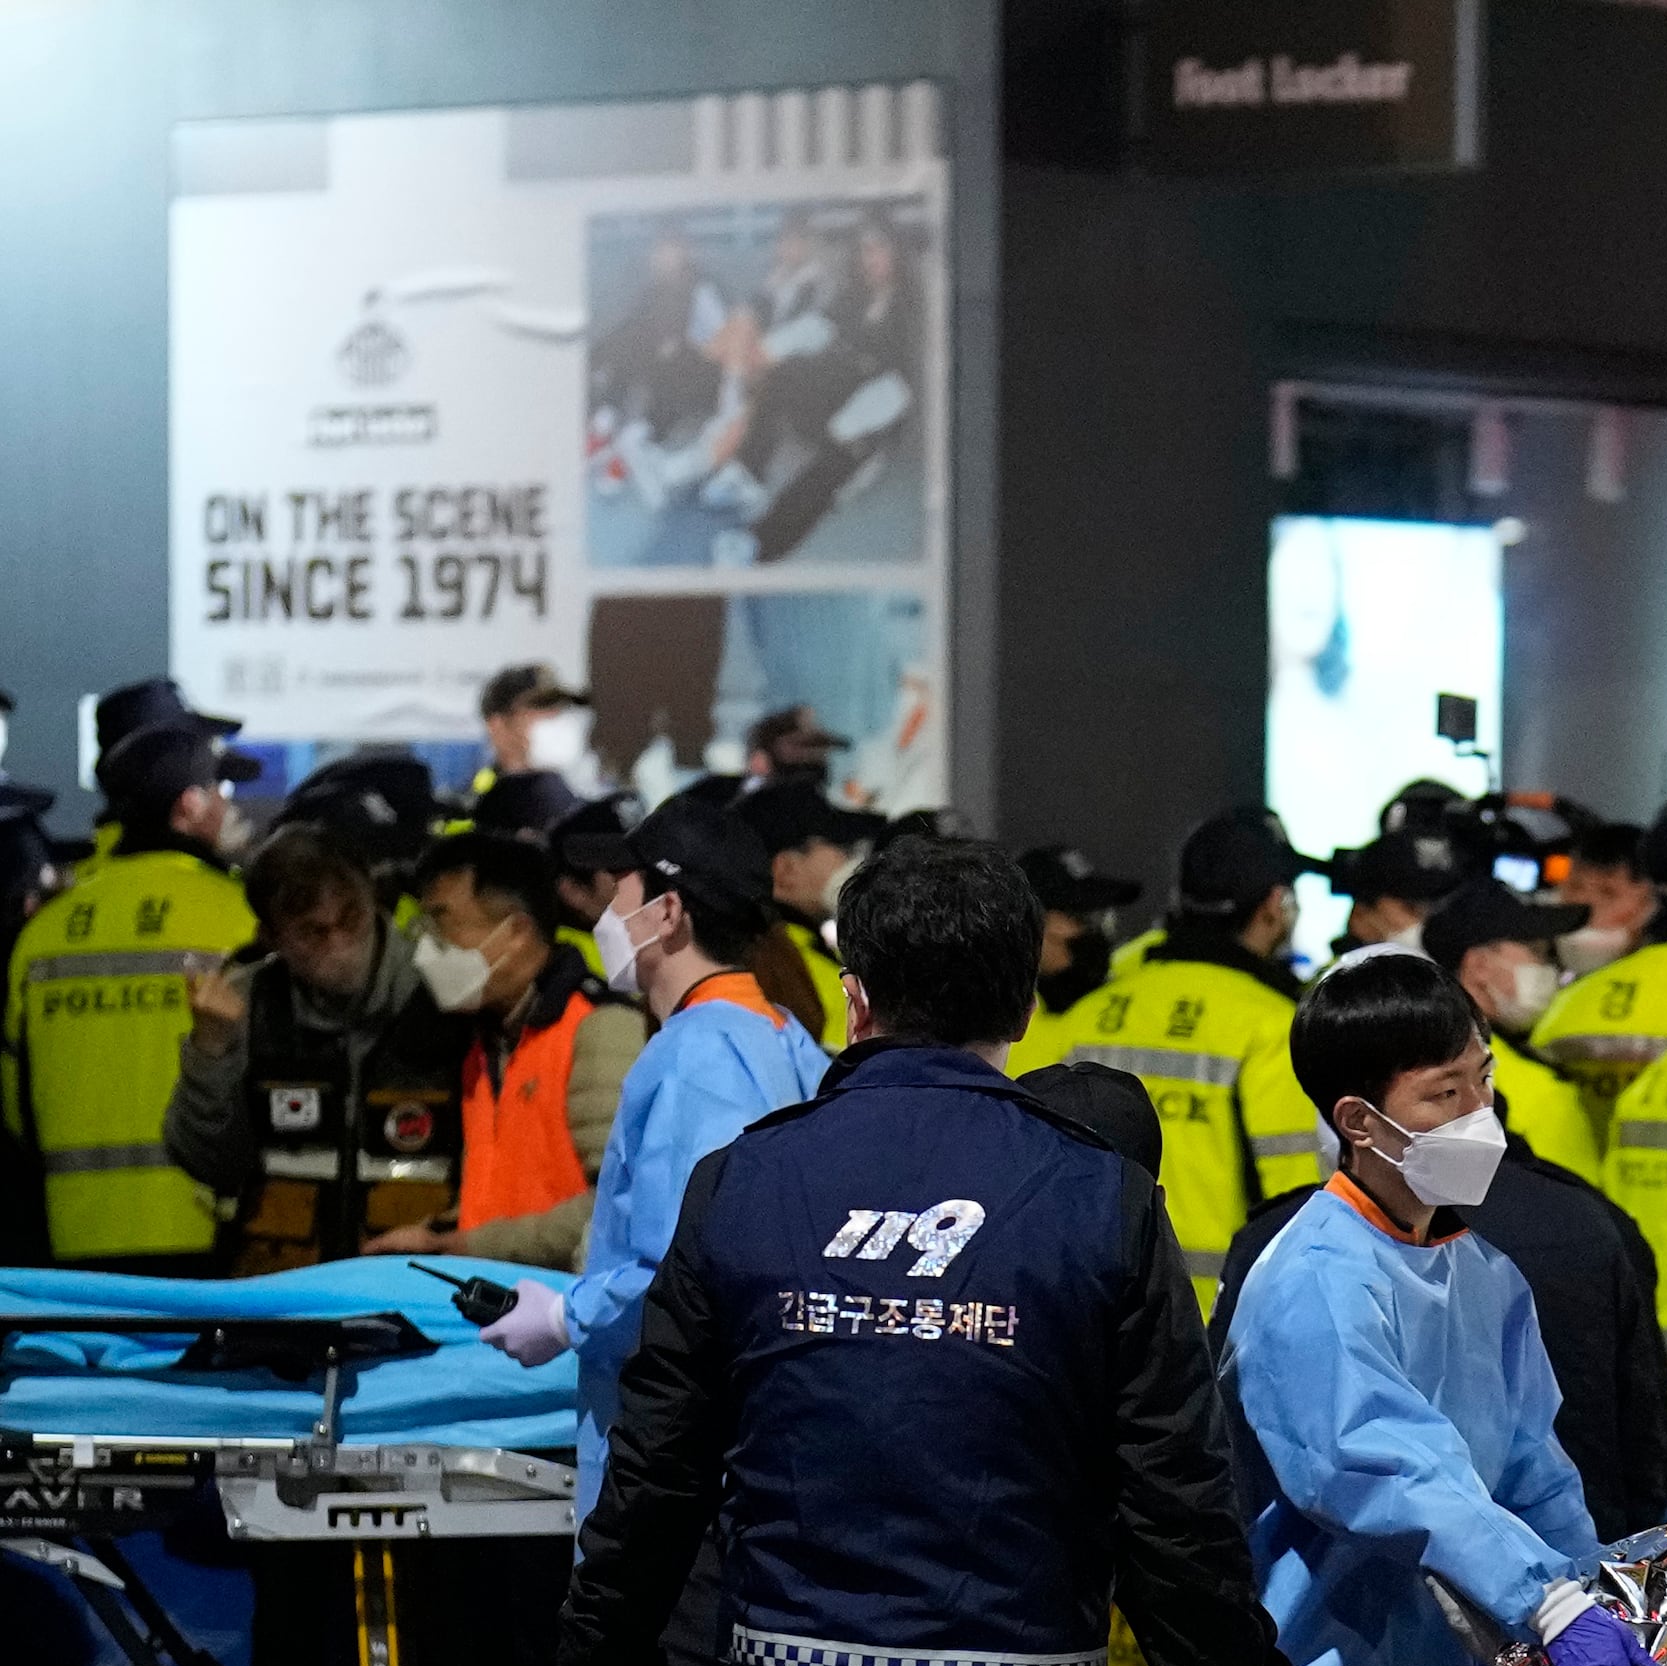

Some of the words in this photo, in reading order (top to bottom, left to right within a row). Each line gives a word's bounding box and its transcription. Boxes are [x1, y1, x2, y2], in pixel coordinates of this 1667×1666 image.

[1175, 57, 1262, 107] Foot
[206, 494, 265, 543] ON
[289, 489, 372, 542] THE
[397, 486, 546, 541] SCENE
[206, 557, 371, 622] SINCE
[402, 554, 546, 618] 1974
[43, 984, 181, 1018] POLICE
[822, 1199, 986, 1277] 119
[778, 1291, 1020, 1347] 긴급구조통제단
